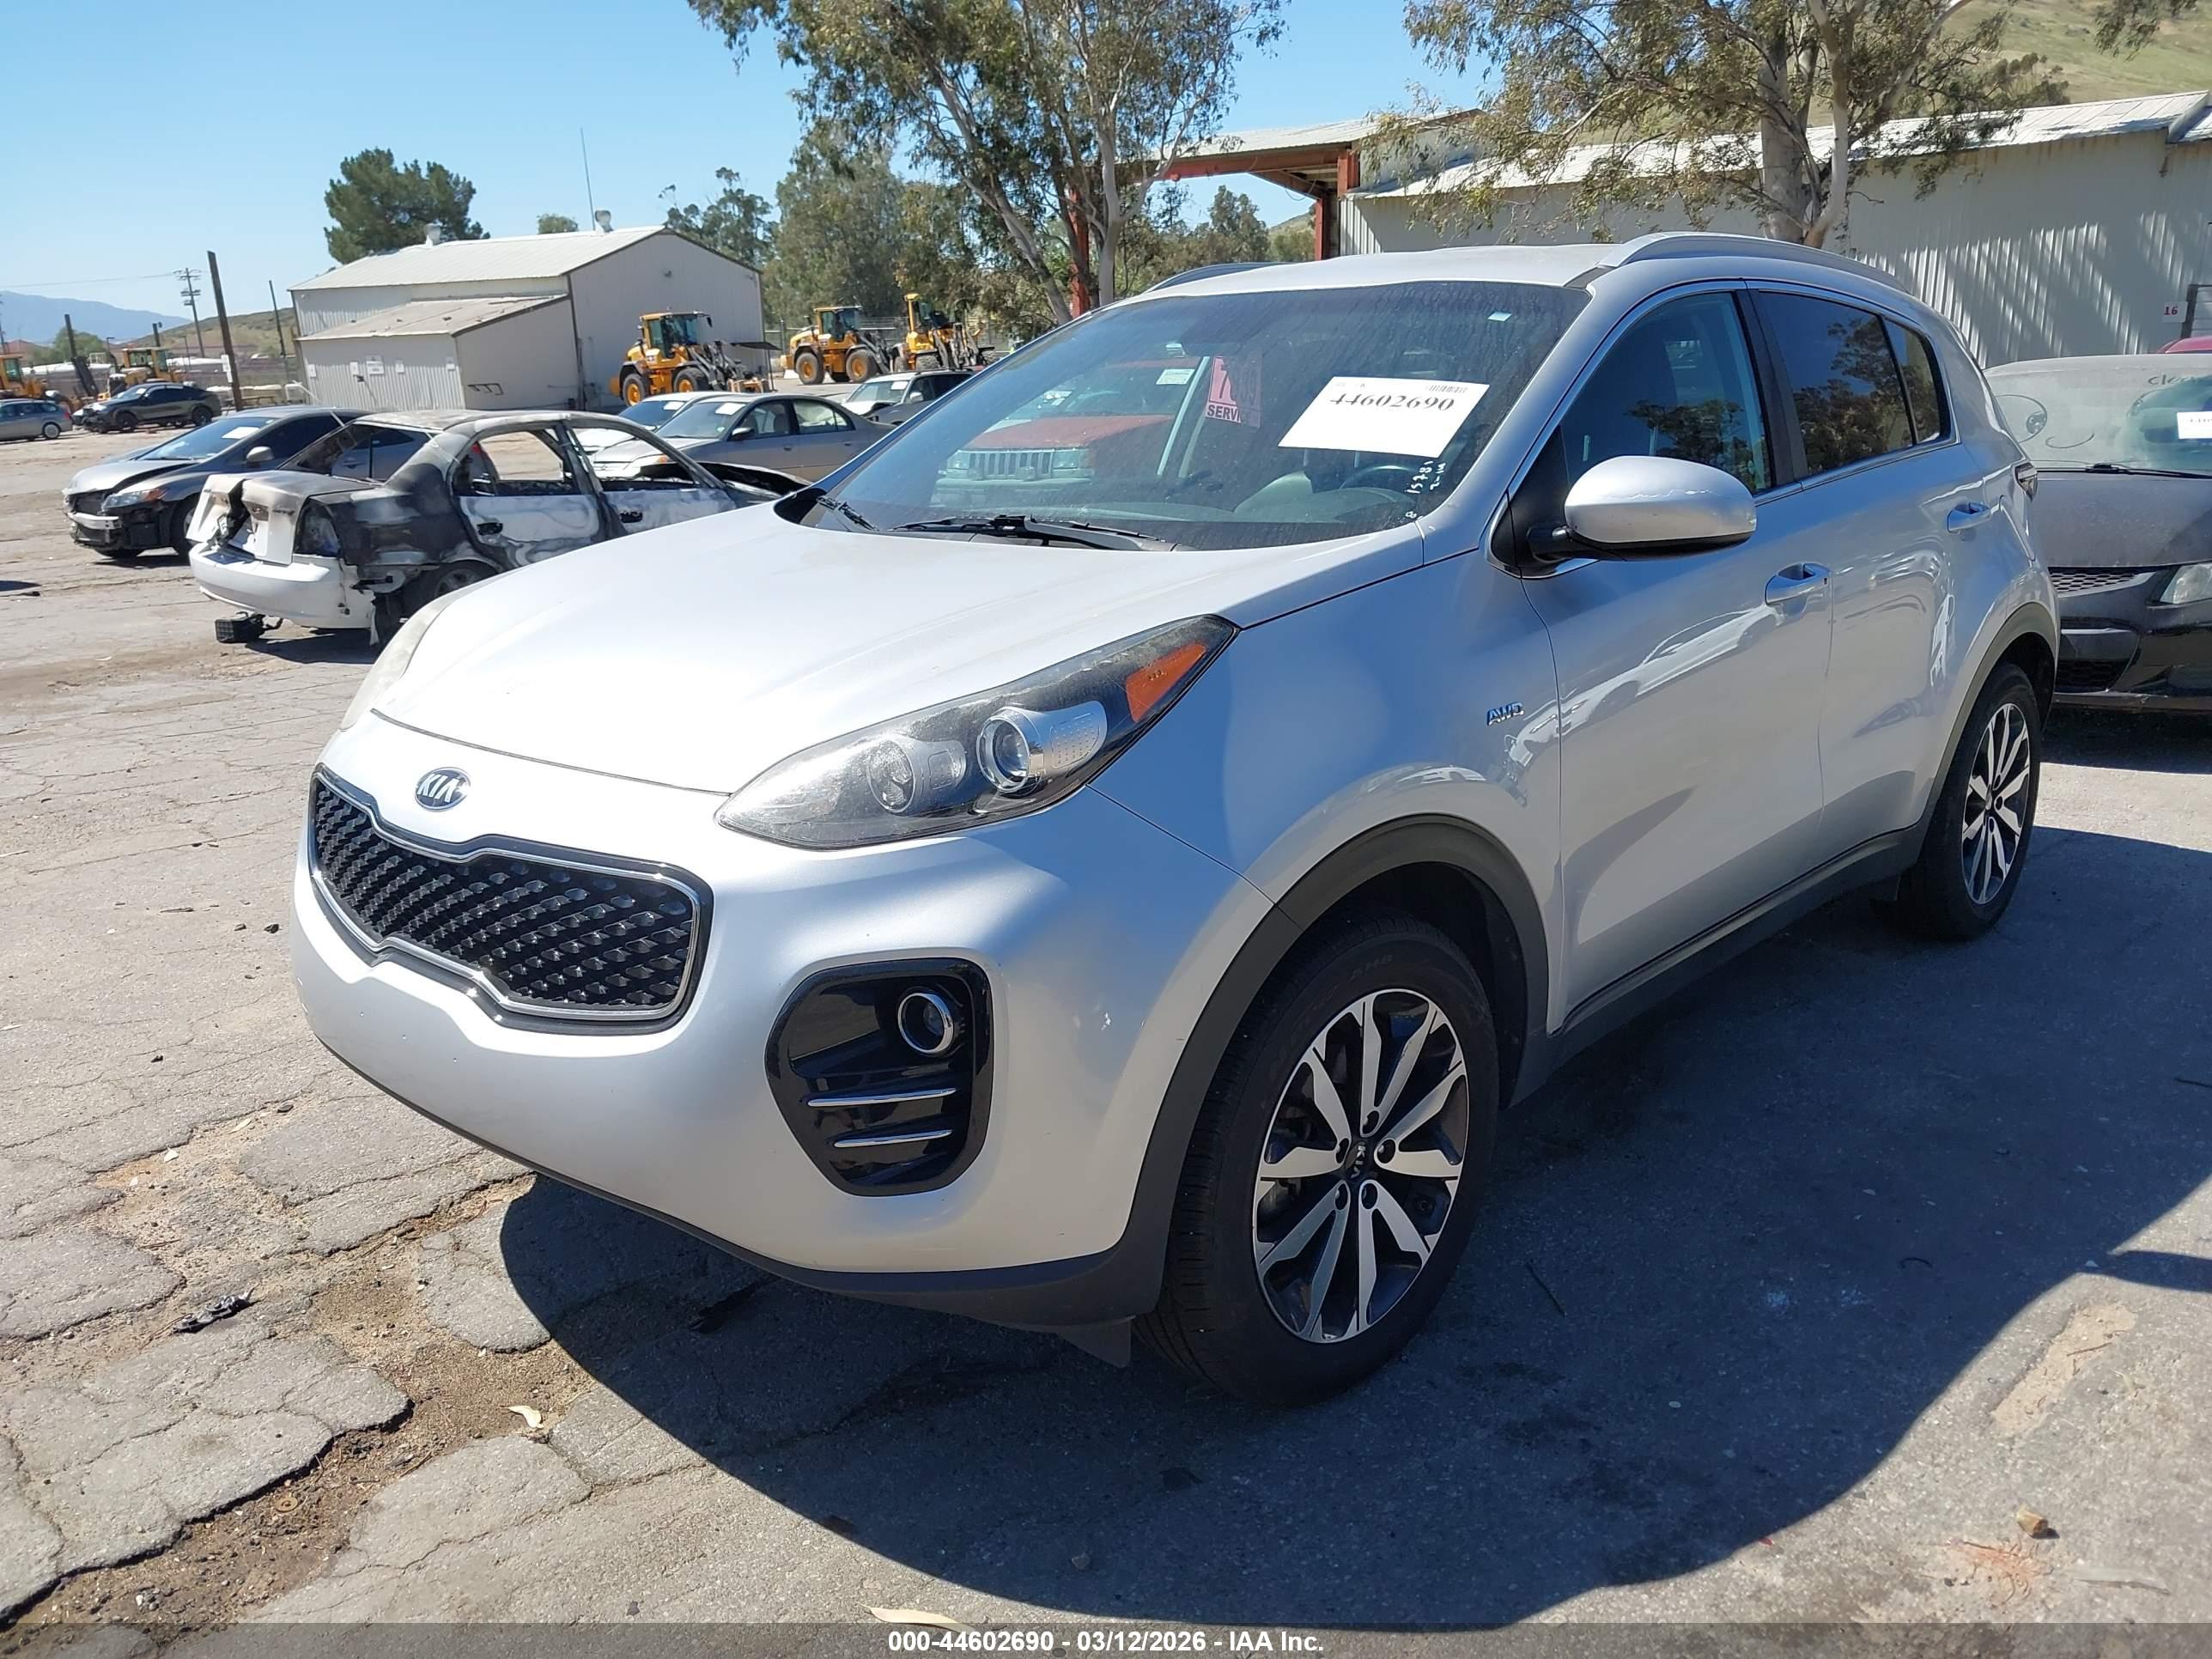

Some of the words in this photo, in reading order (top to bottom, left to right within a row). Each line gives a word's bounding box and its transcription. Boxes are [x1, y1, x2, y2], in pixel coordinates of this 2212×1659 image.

[2164, 306, 2179, 316] 16
[1330, 393, 1455, 411] 44602690
[1486, 701, 1524, 726] AWD
[416, 772, 461, 804] KIA
[1350, 1145, 1366, 1179] KIA
